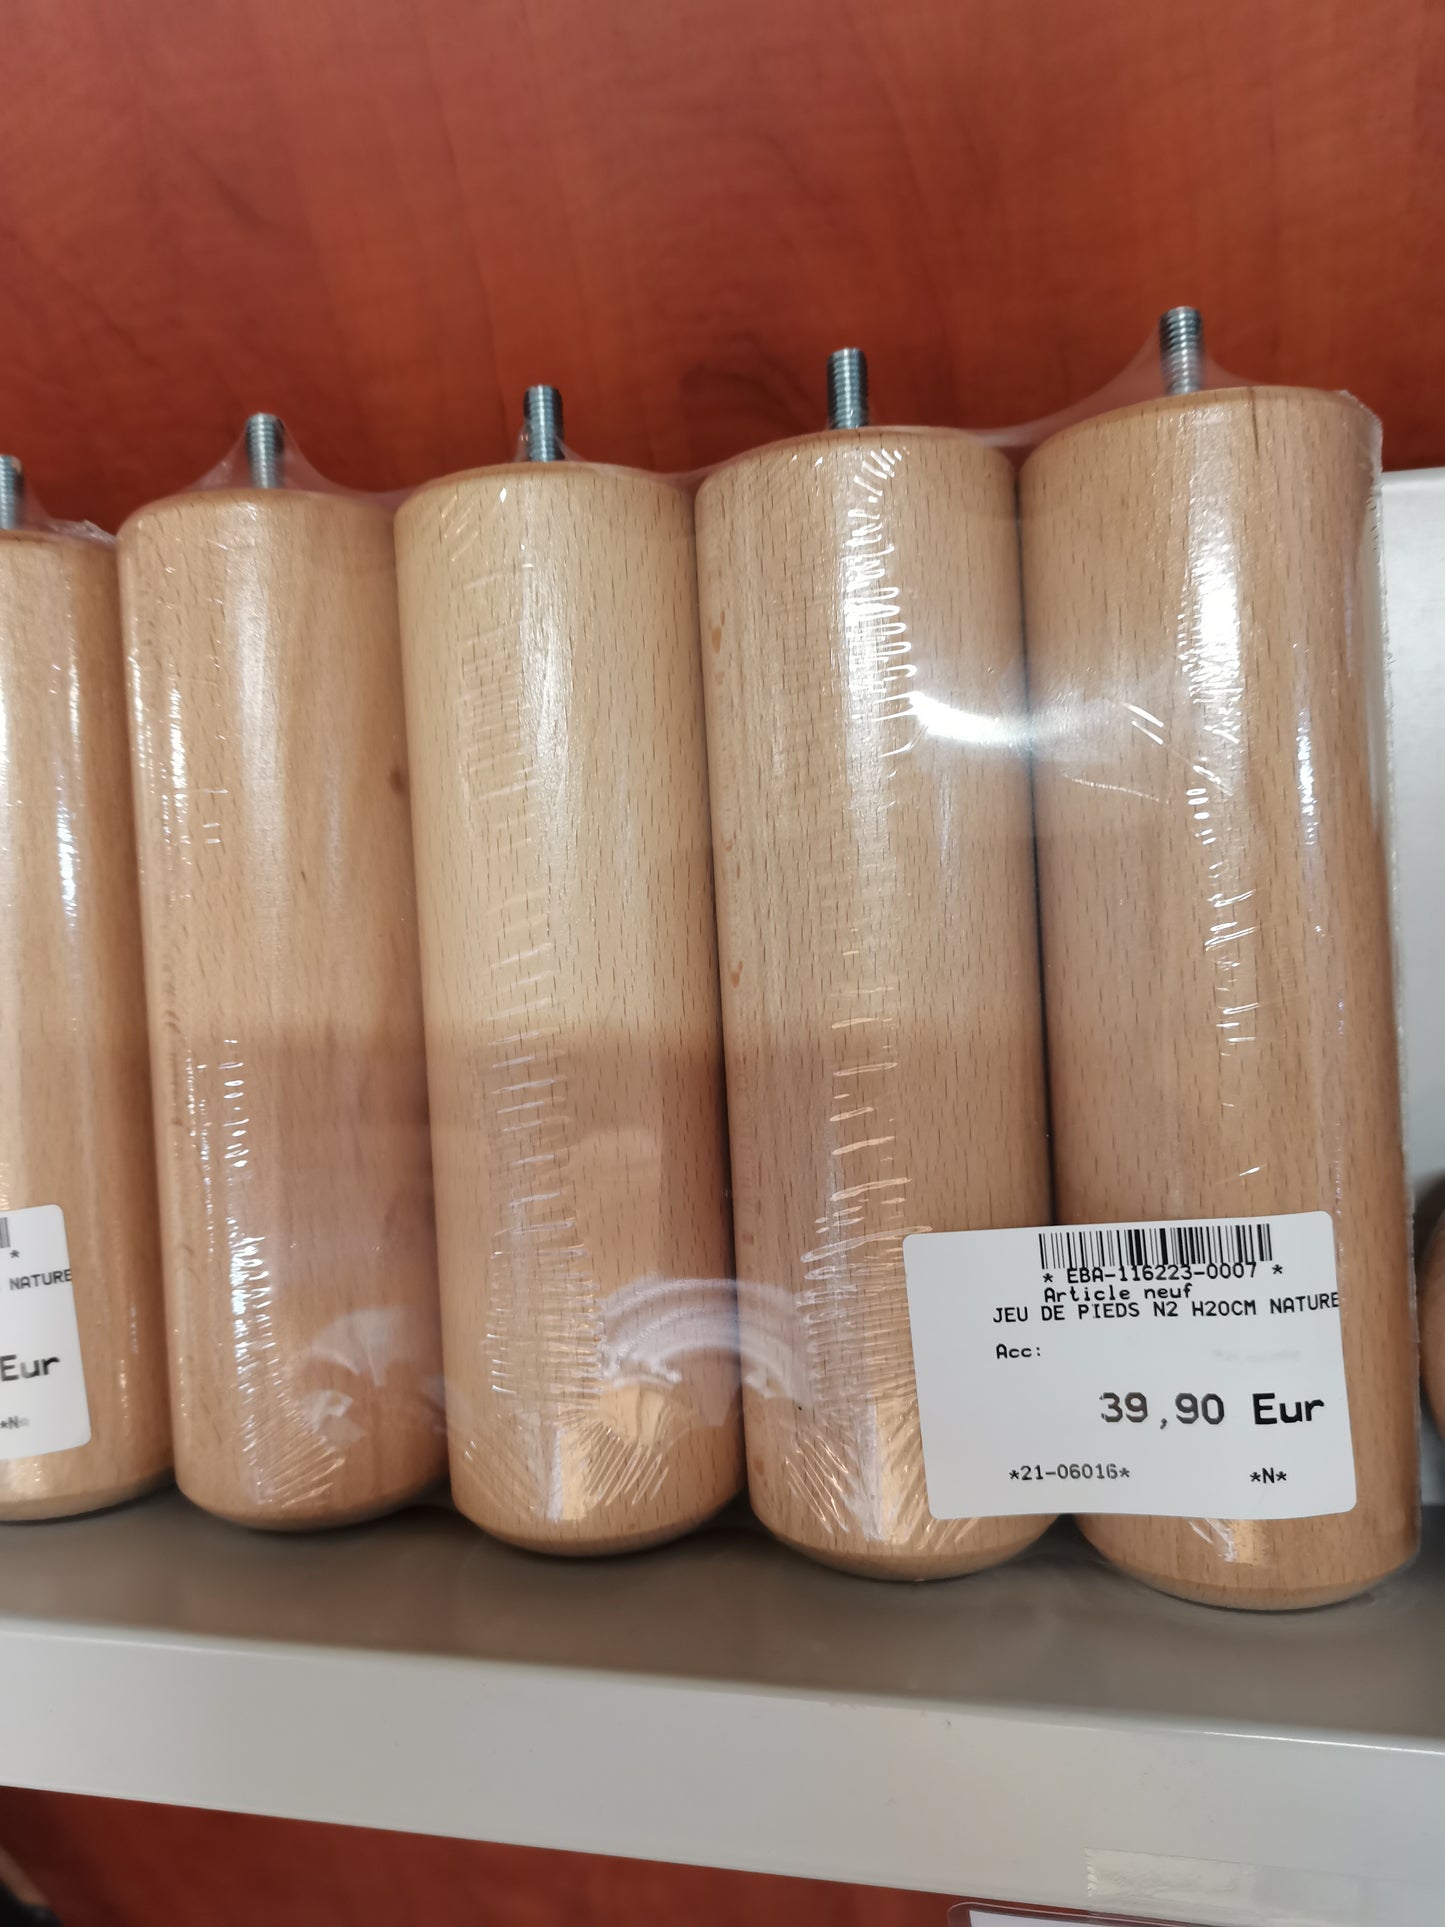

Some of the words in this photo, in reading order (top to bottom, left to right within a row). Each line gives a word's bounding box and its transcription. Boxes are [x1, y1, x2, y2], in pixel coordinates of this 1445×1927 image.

[9, 1269, 72, 1290] NATURE
[1066, 1262, 1257, 1284] EBA-116223-0007
[1044, 1287, 1131, 1303] Article
[1144, 1283, 1193, 1300] neuf
[993, 1306, 1029, 1324] JEU
[1041, 1305, 1066, 1321] DE
[1078, 1303, 1141, 1319] PIEDS
[1153, 1302, 1179, 1318] N2
[1270, 1291, 1340, 1314] NATURE
[996, 1344, 1042, 1360] Acc:
[0, 1354, 60, 1381] Eur
[1100, 1392, 1225, 1430] 39,90
[1252, 1393, 1325, 1425] Eur
